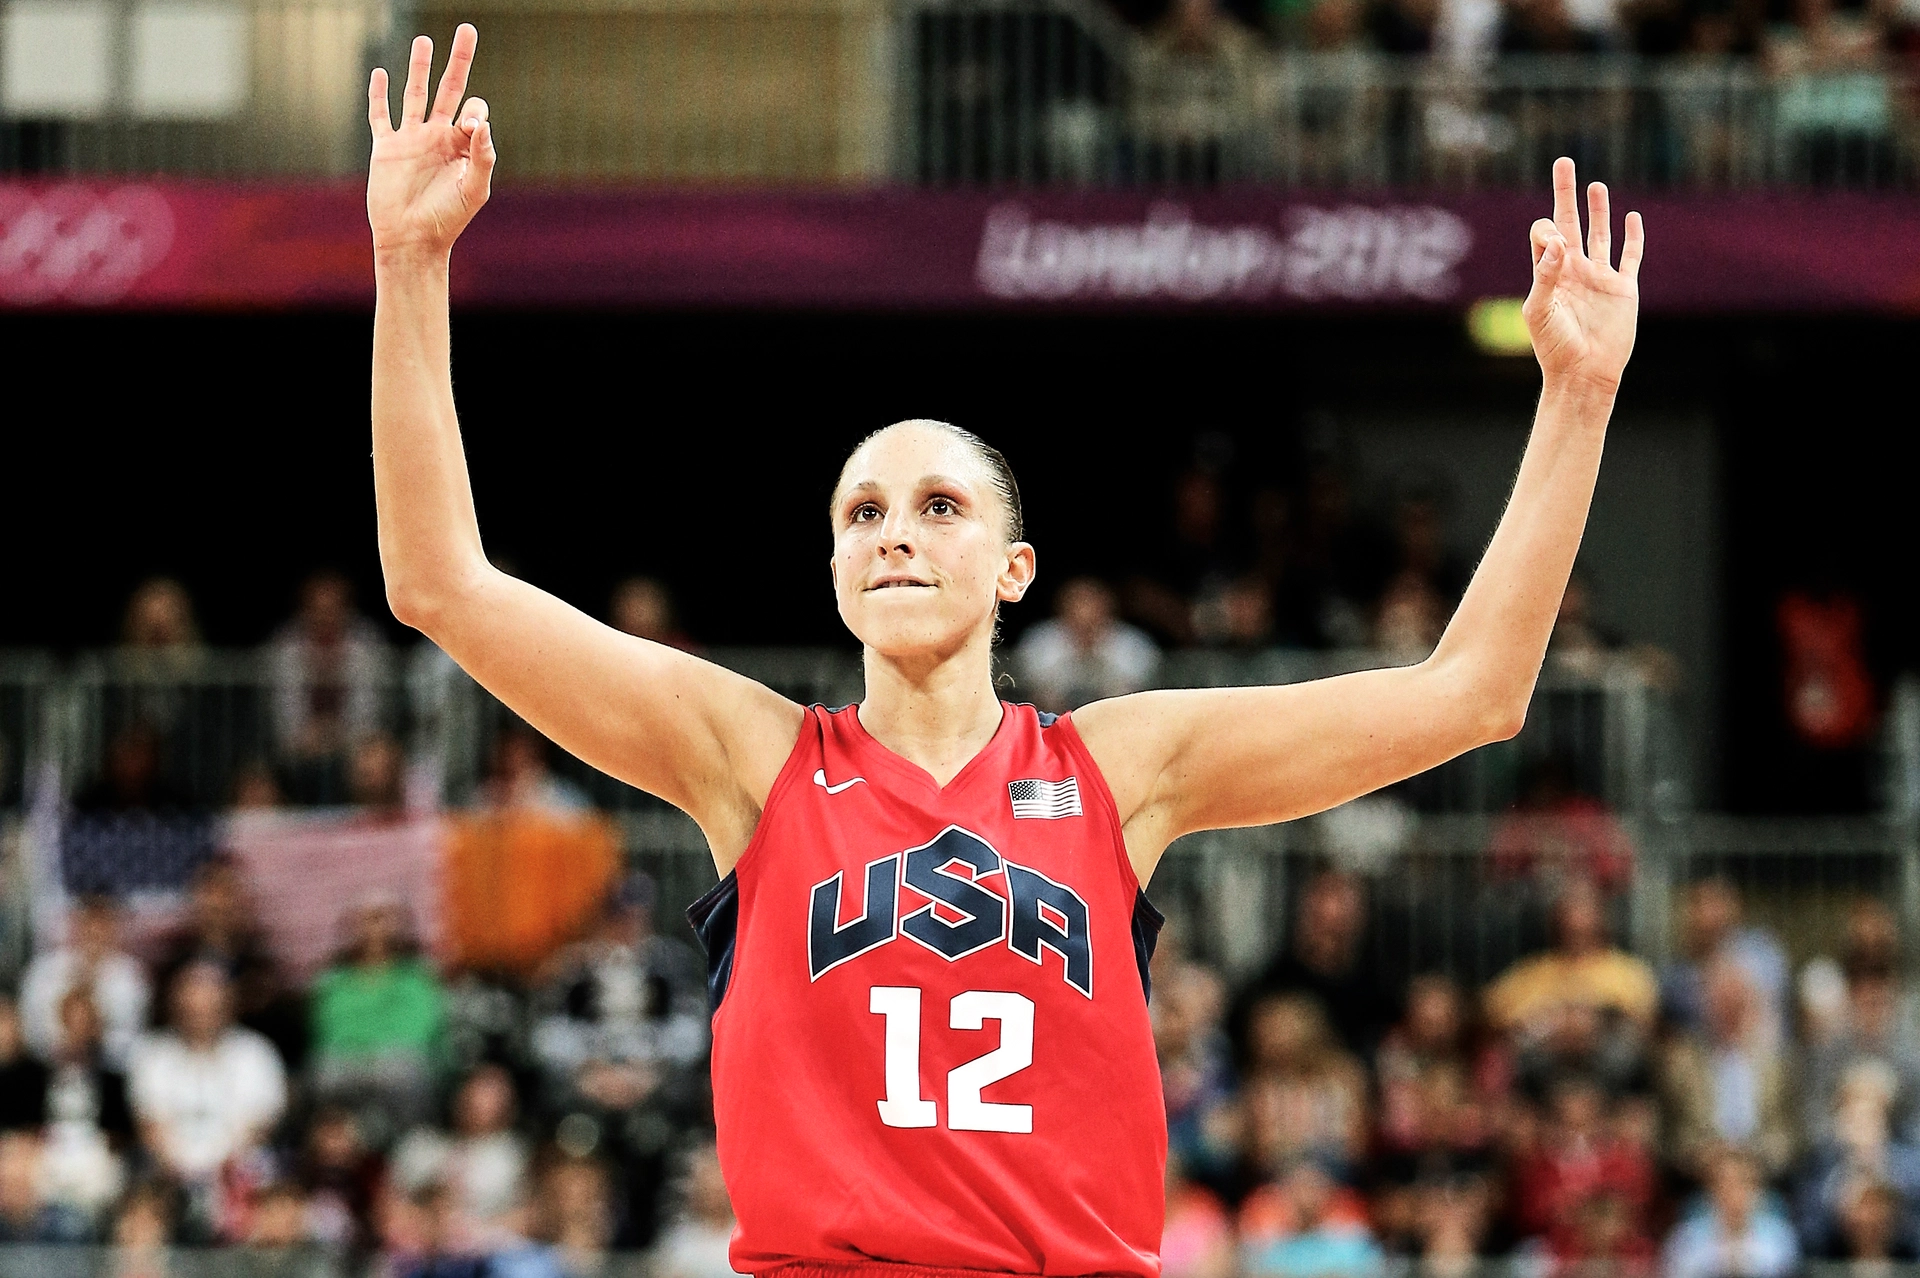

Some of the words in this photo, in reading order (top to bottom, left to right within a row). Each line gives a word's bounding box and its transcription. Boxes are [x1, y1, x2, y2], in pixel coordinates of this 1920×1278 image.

[979, 204, 1282, 297] London
[1284, 205, 1472, 298] 2012
[807, 824, 1093, 1000] USA
[869, 985, 1035, 1133] 12
